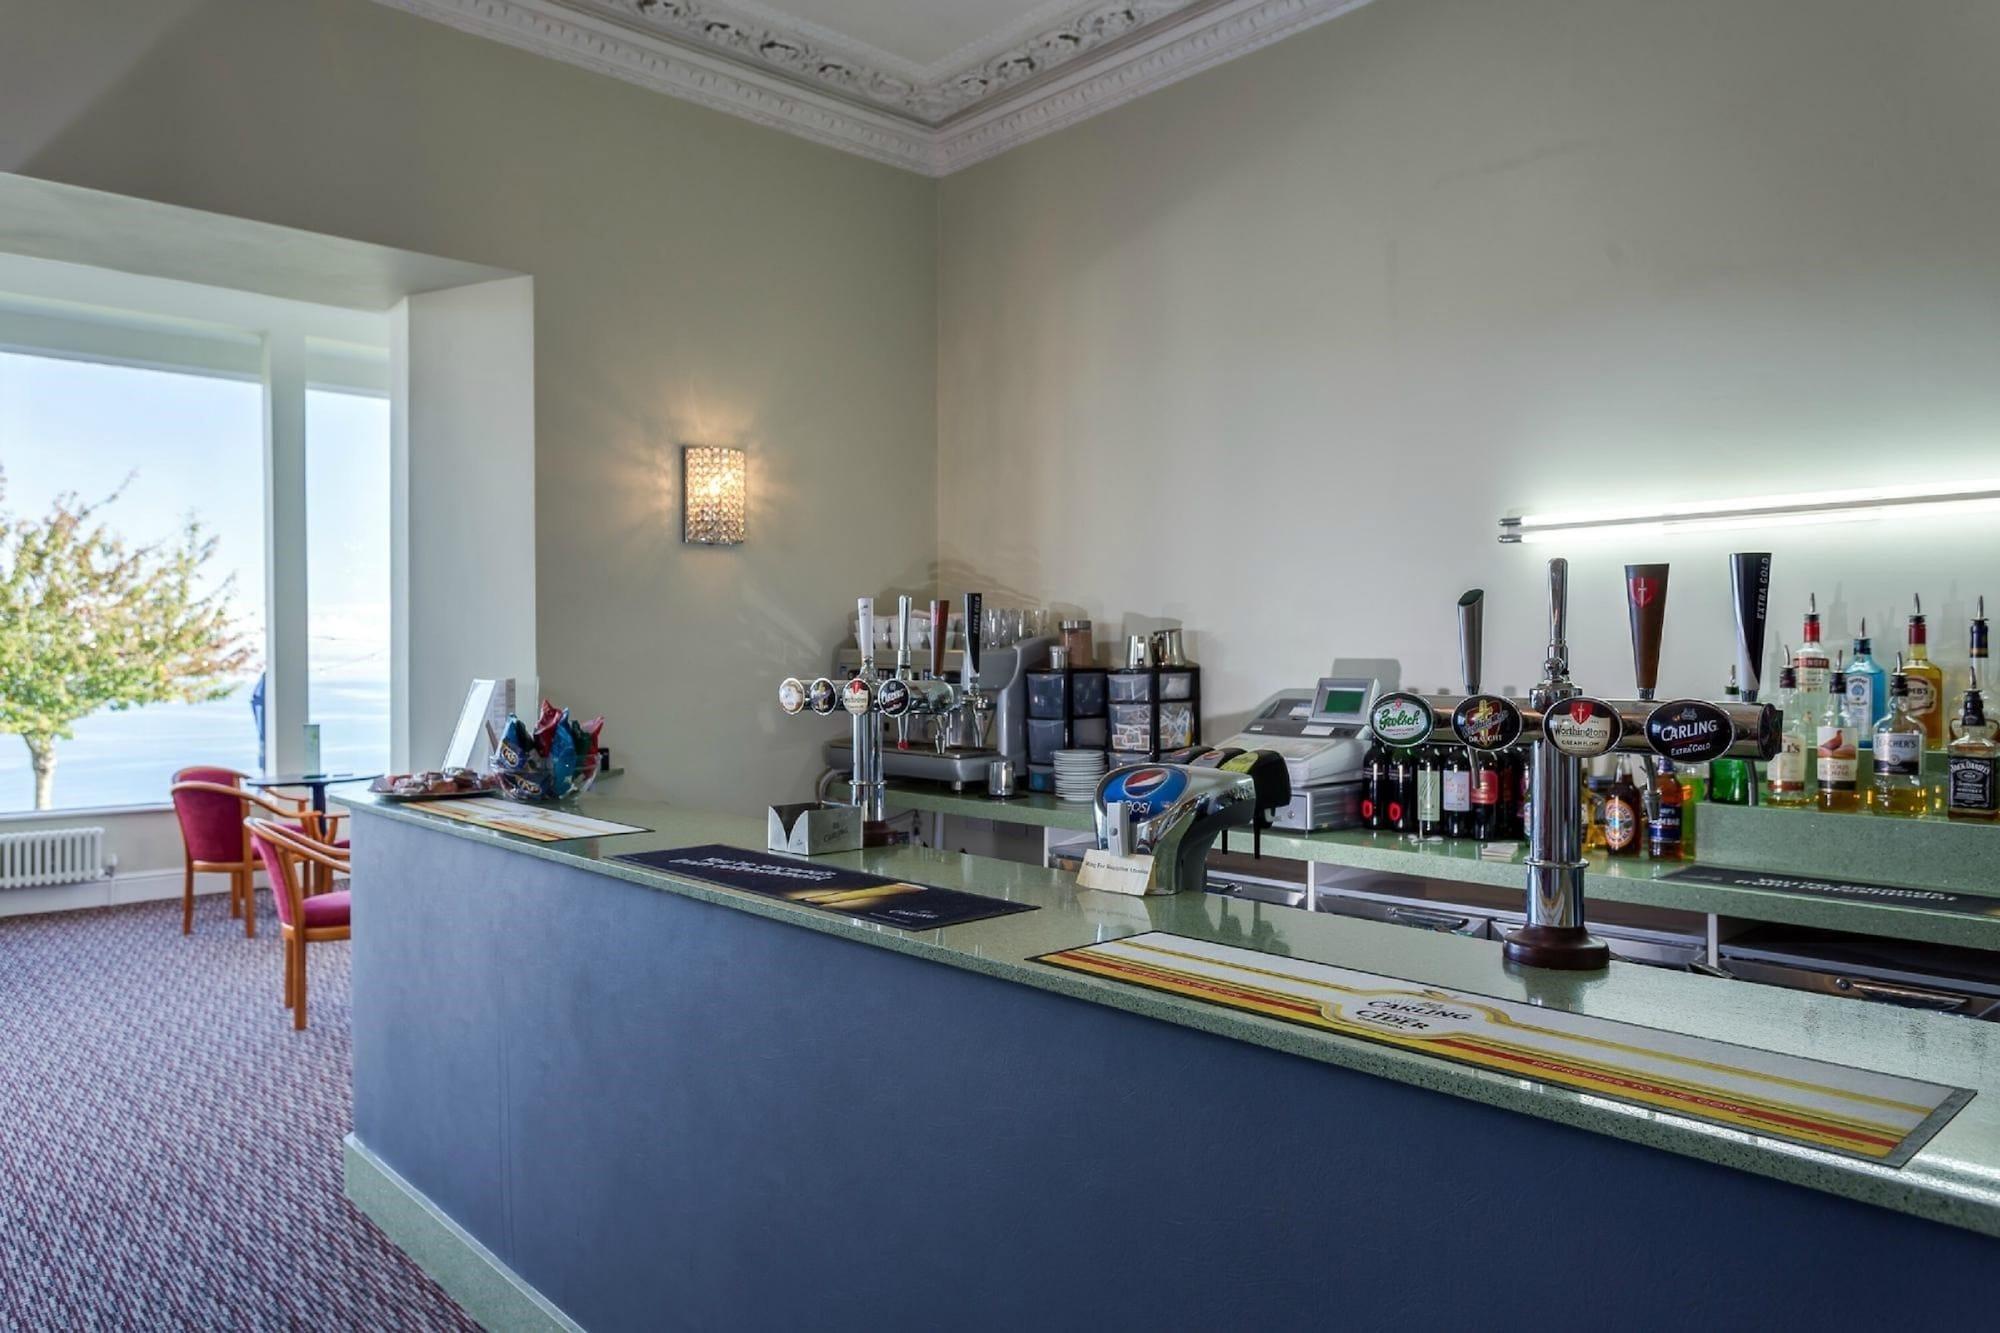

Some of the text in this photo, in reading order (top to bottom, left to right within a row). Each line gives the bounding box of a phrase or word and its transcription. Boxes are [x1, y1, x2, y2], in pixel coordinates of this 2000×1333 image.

[1757, 557, 1770, 620] EXTRA COLD
[1378, 708, 1420, 730] Grolsch
[1660, 719, 1718, 742] CARLING
[1692, 742, 1711, 752] COLD
[1875, 737, 1917, 748] TECHER'S
[1356, 1010, 1430, 1029] CIDER
[1367, 1001, 1473, 1020] CARLING
